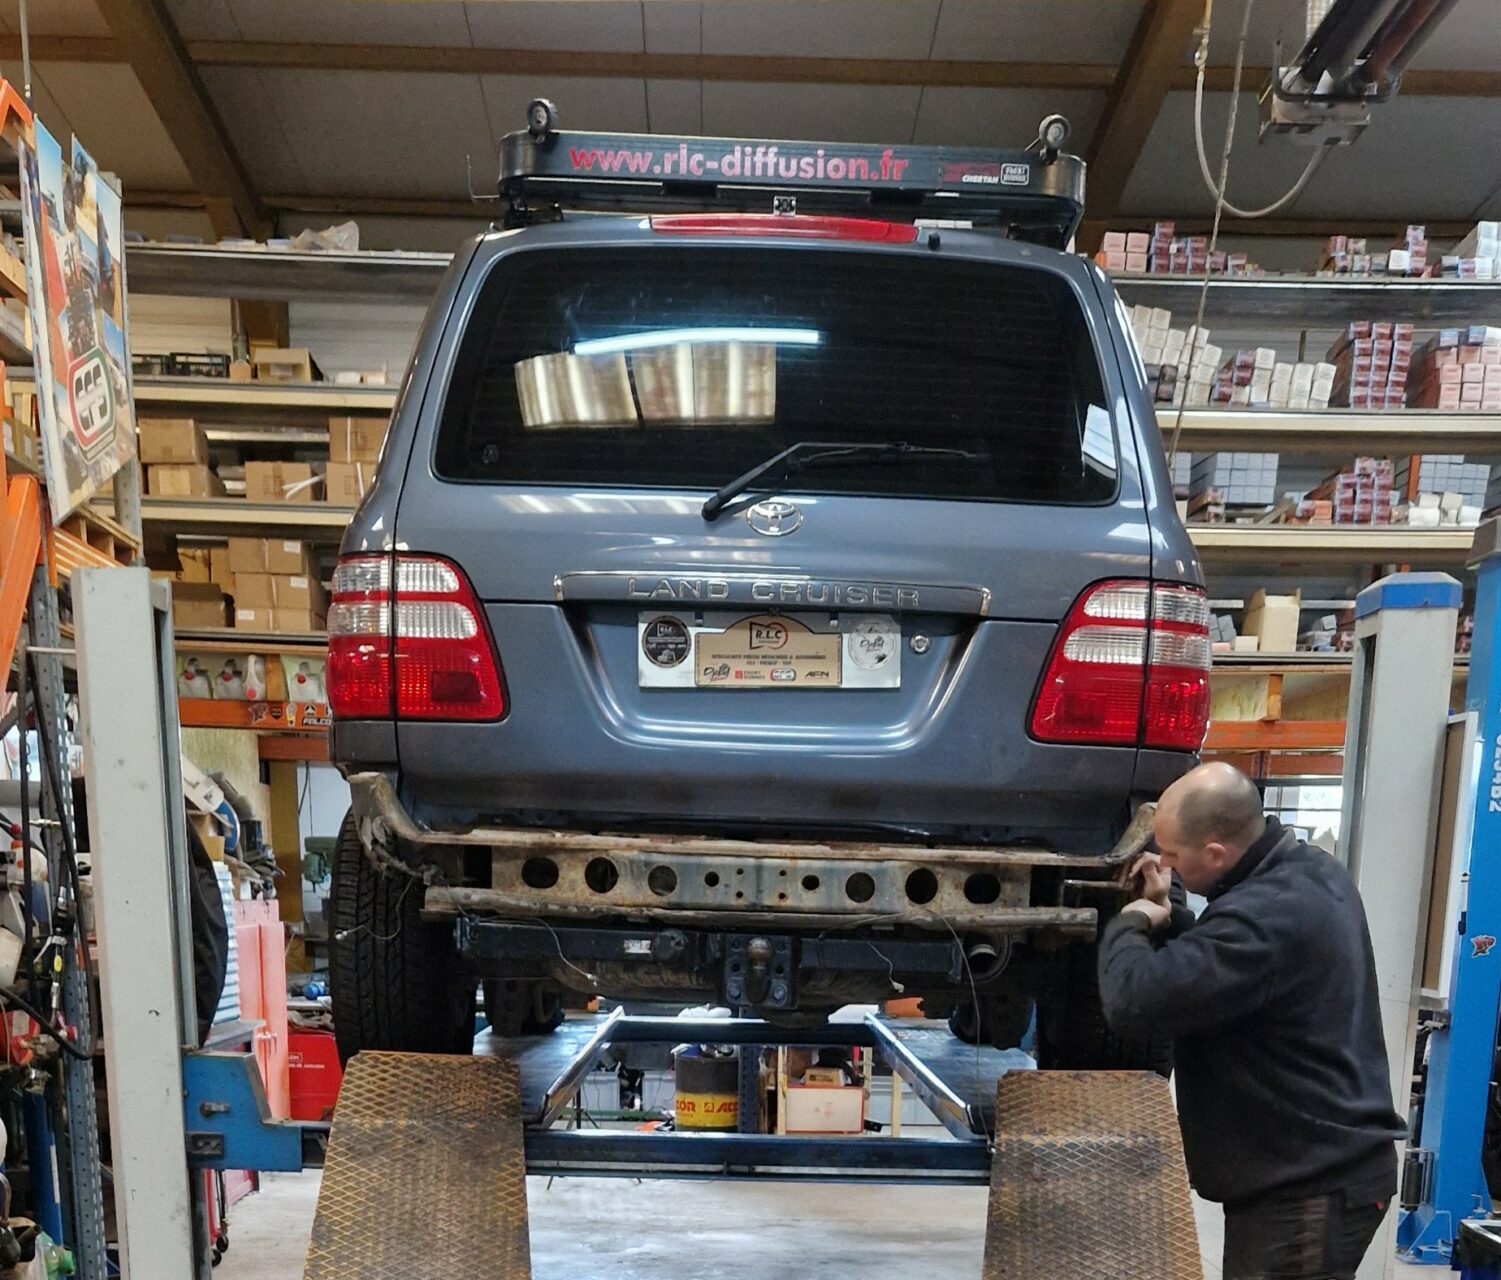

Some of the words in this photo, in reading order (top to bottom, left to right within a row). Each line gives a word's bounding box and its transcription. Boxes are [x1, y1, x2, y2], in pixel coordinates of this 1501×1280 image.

[570, 143, 909, 181] www.rlc-diffusion.fr
[629, 578, 729, 599] LAND
[752, 582, 919, 607] CRUISER
